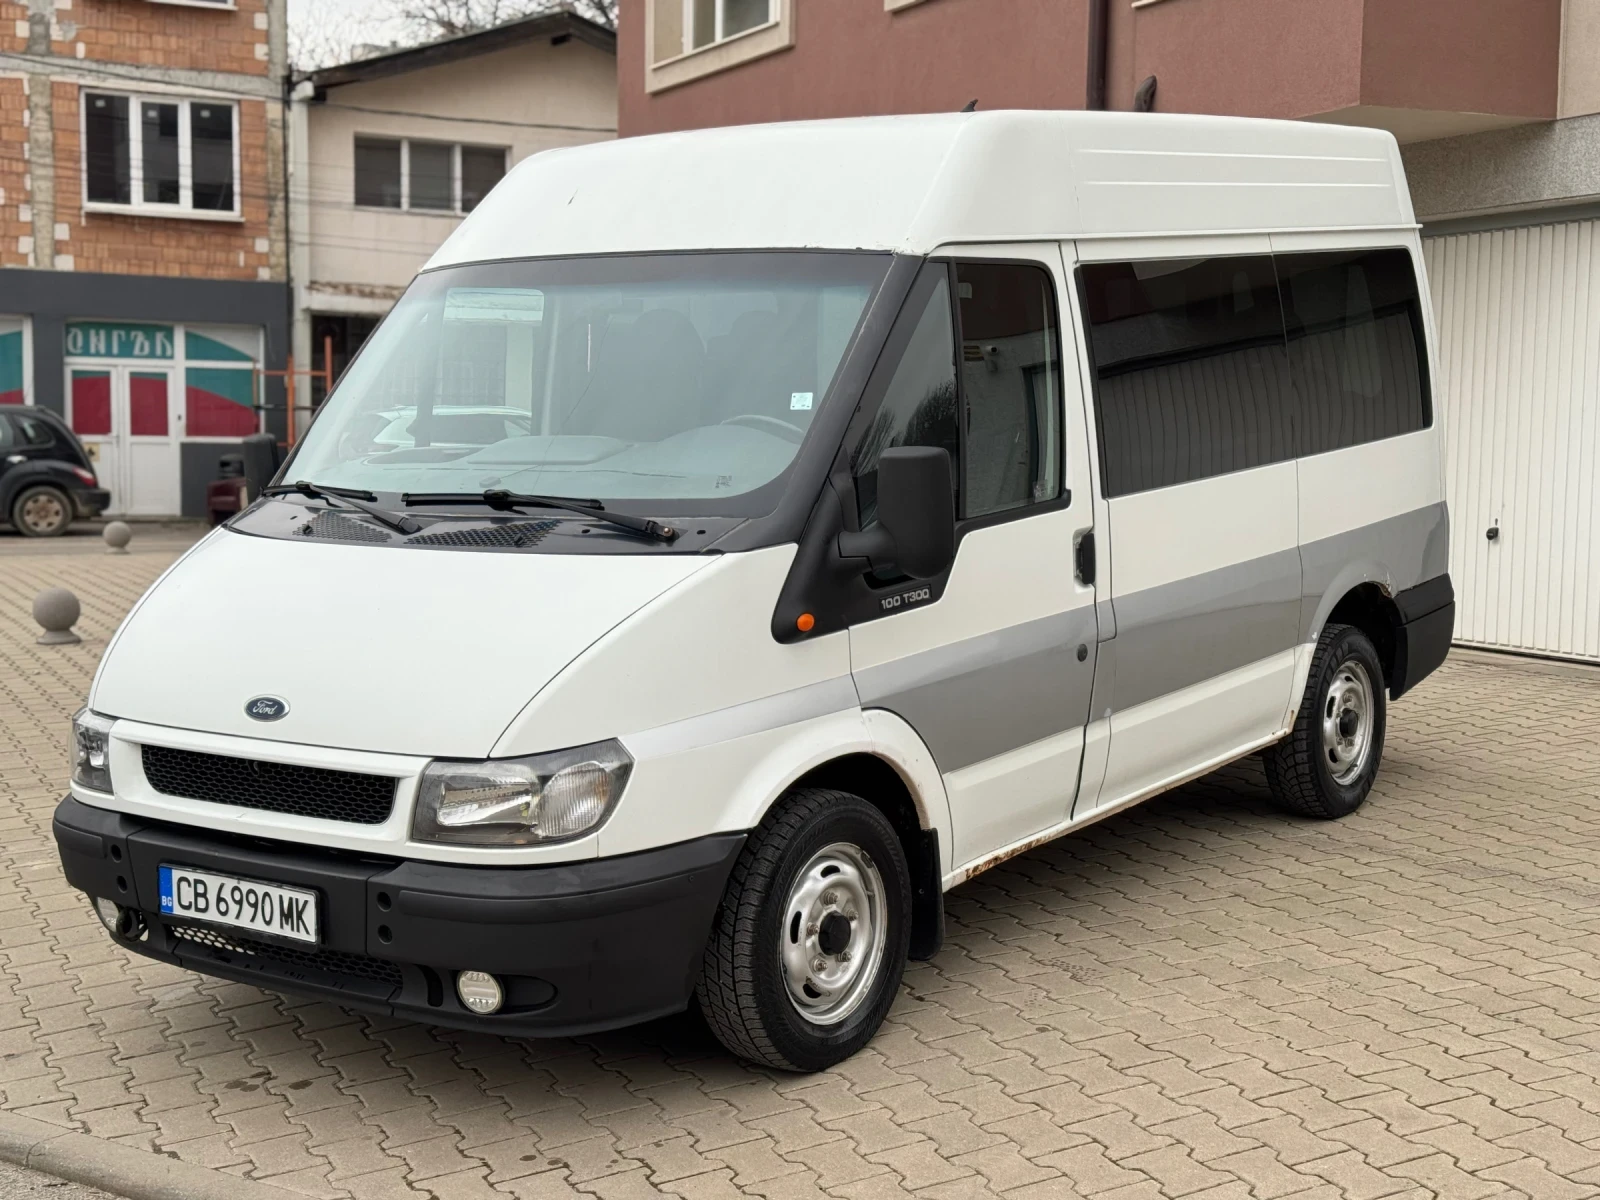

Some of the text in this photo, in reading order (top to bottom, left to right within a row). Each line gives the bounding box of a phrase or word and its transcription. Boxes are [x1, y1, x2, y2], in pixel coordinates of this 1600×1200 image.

[881, 588, 930, 609] 100 T300
[252, 700, 278, 715] Ford
[161, 896, 173, 907] BG
[176, 876, 311, 935] CB 6990 MK
